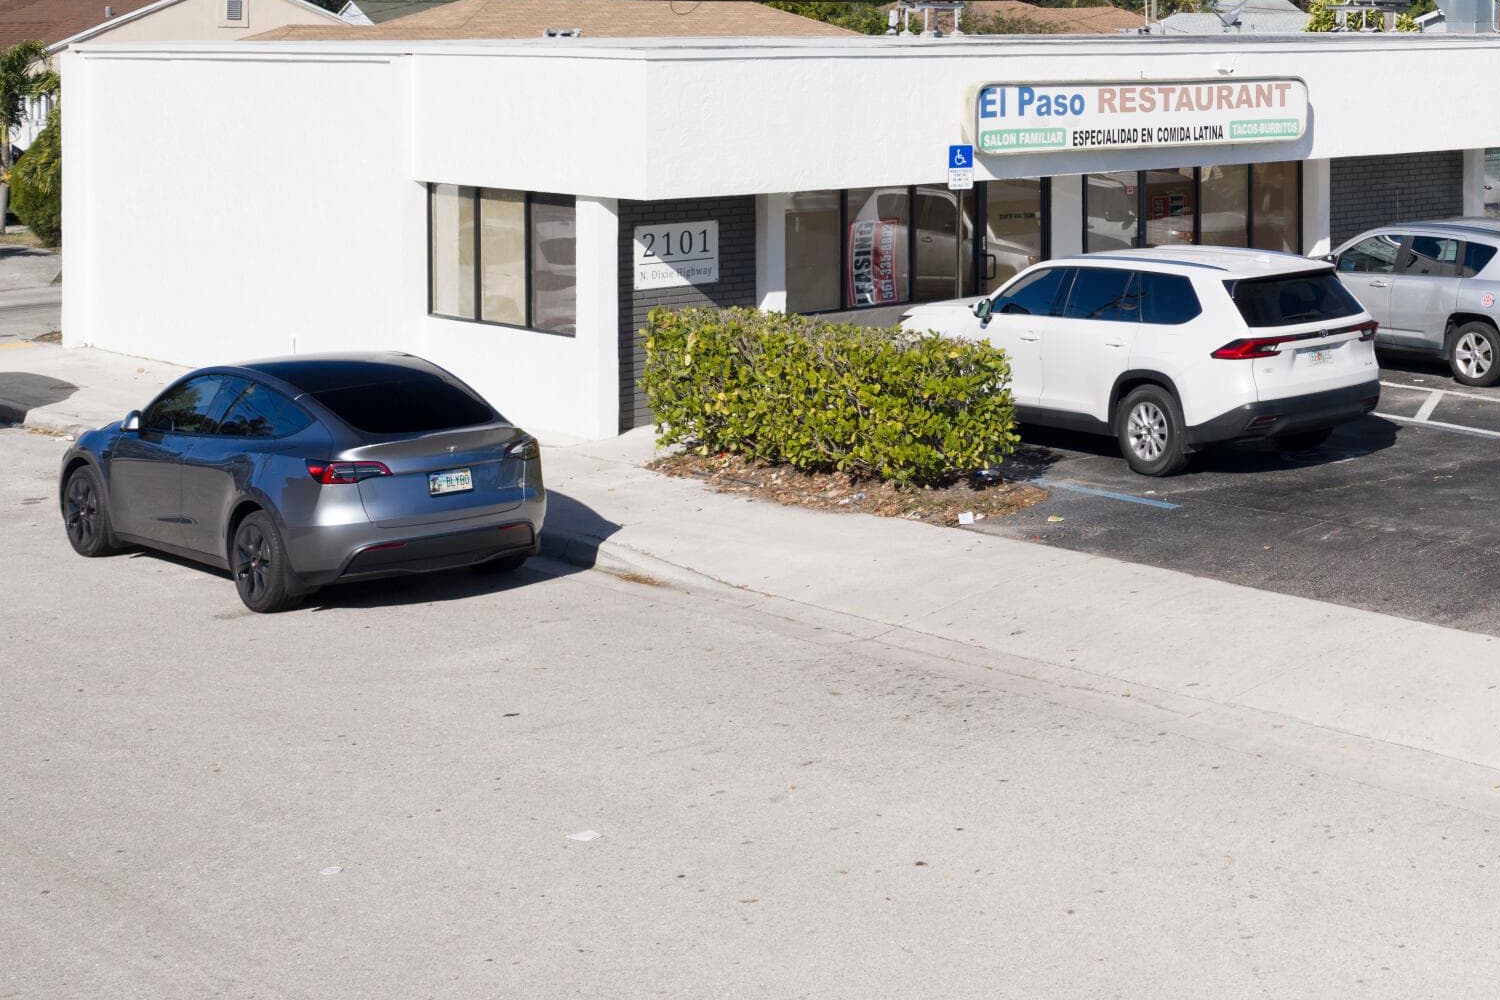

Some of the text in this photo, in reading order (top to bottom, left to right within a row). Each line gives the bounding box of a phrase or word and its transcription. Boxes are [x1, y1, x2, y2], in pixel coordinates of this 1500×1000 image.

[980, 83, 1292, 119] El Paso RESTAURANT
[1072, 125, 1224, 147] ESPECIALIDAD EN COMIDA LATINA
[1231, 121, 1298, 136] TACOS-BURRITOS
[983, 130, 1064, 147] SALON FAMILIAR
[642, 228, 711, 258] 2101
[651, 269, 675, 280] Dixie
[676, 266, 713, 279] Highway
